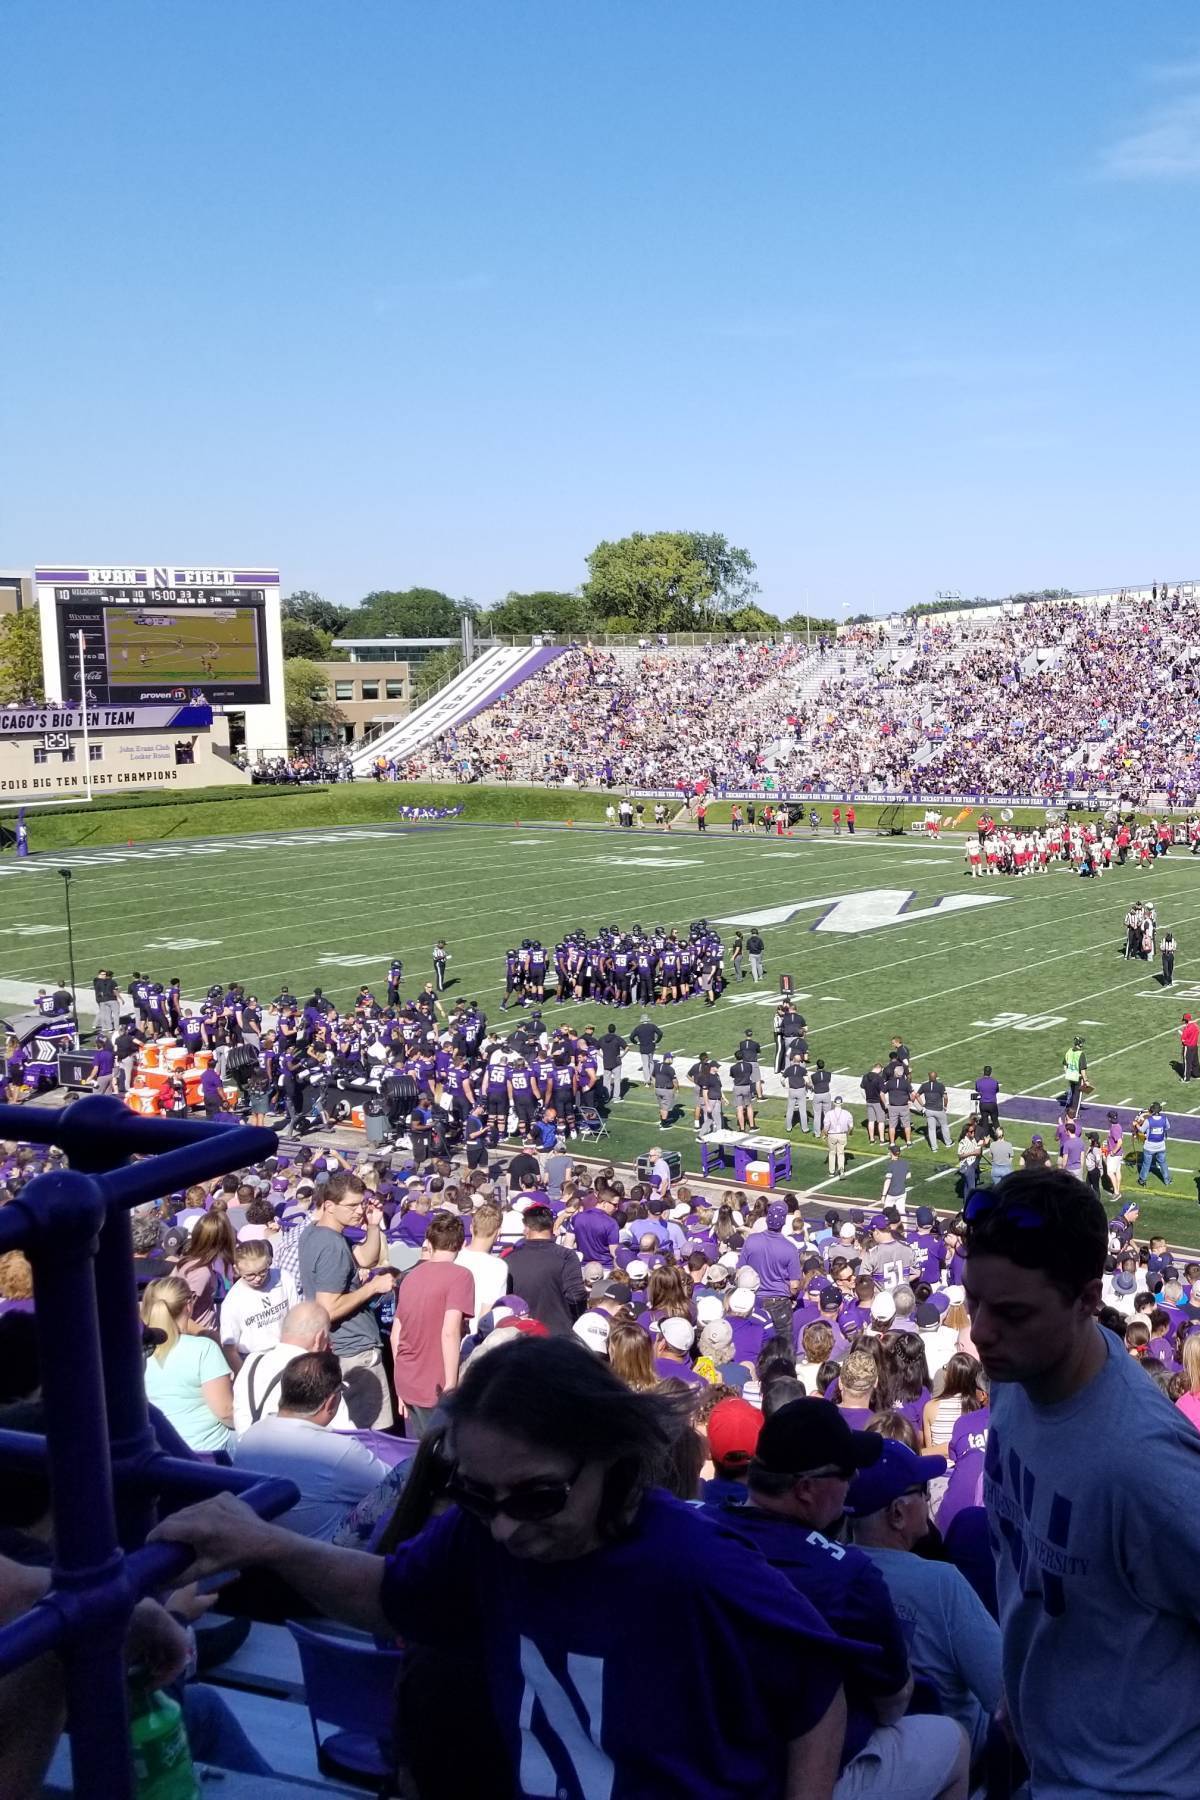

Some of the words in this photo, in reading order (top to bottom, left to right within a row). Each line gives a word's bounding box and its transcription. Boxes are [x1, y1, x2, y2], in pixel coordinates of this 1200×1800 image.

[88, 570, 136, 585] RYAN
[153, 568, 169, 589] N
[183, 569, 235, 586] FIELD
[151, 590, 176, 601] 15:00
[140, 692, 172, 700] proven
[52, 713, 73, 727] BIG
[78, 712, 100, 726] TEN
[104, 711, 135, 725] TEAM
[1, 779, 28, 790] 2018
[33, 777, 52, 788] BIG
[56, 776, 78, 787] TEN
[117, 770, 177, 783] CHAMPIONS
[969, 1012, 1068, 1031] 30
[187, 1023, 200, 1035] 86
[490, 1069, 505, 1083] 56
[512, 1077, 527, 1090] 69
[751, 1172, 759, 1181] G
[883, 1259, 904, 1291] 51
[260, 1296, 272, 1307] N
[519, 1633, 616, 1800] N
